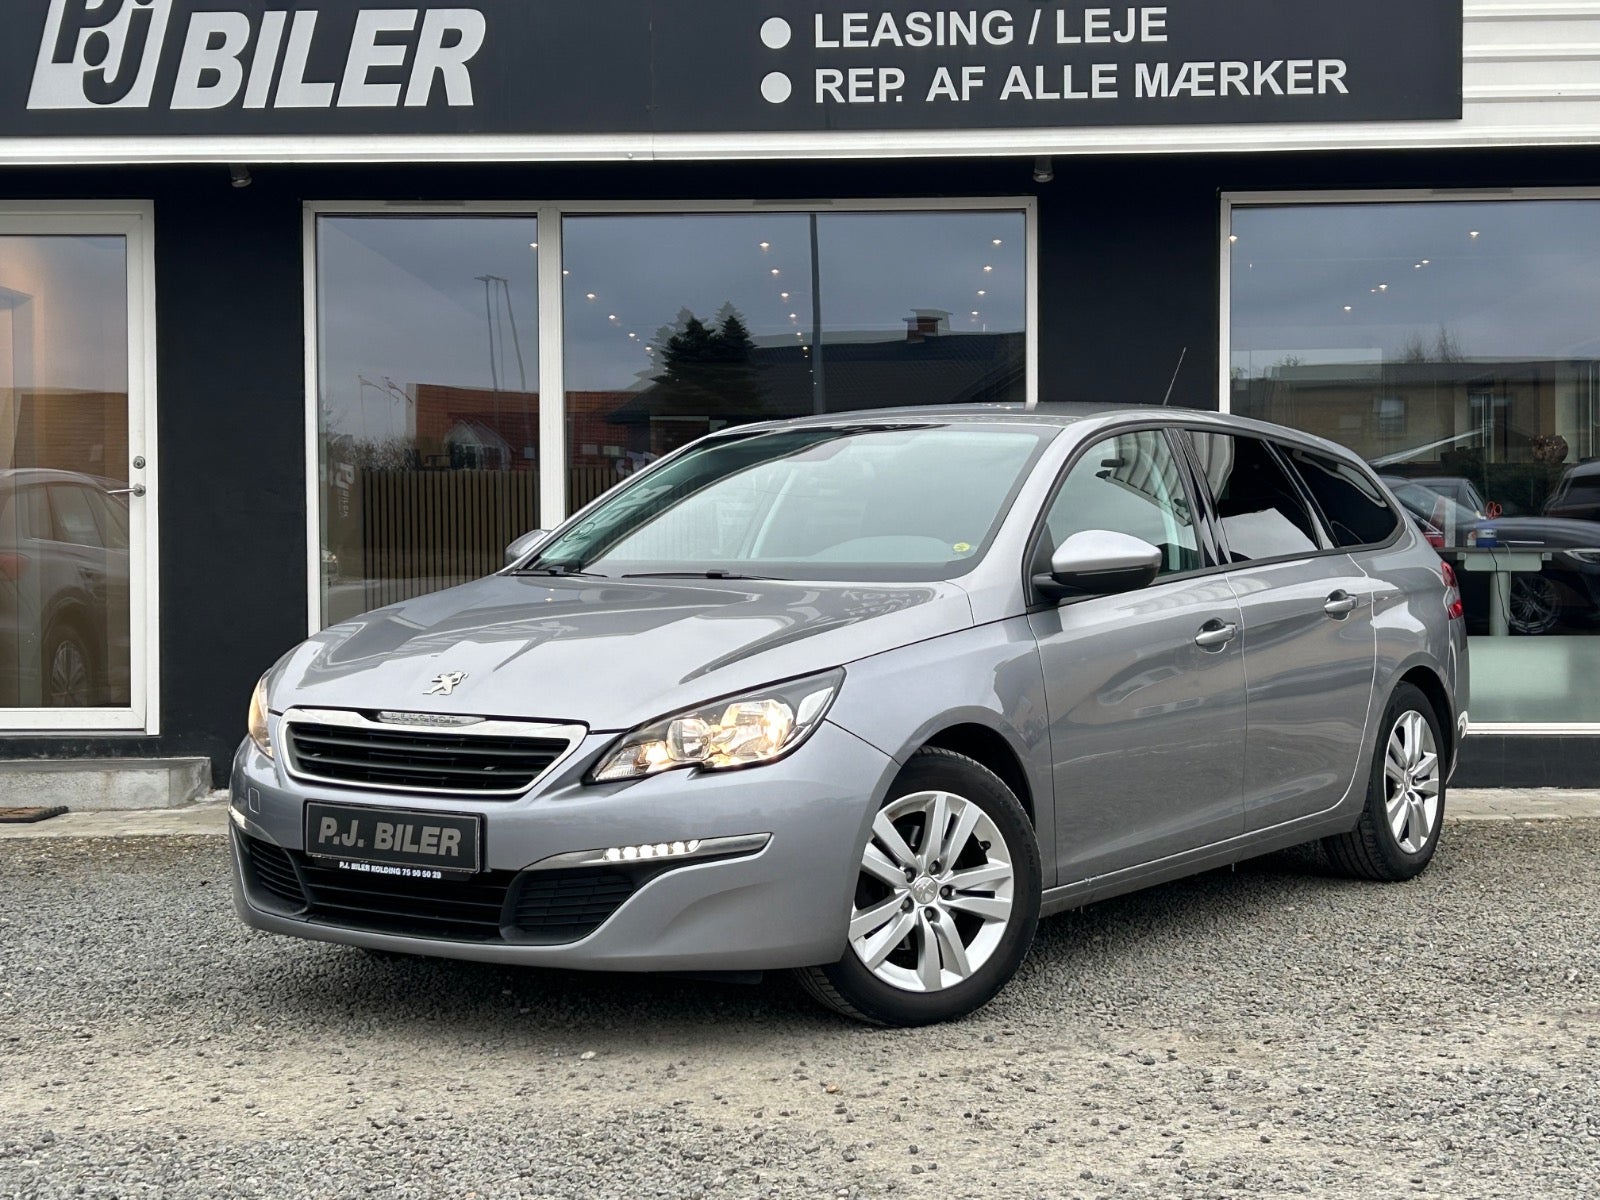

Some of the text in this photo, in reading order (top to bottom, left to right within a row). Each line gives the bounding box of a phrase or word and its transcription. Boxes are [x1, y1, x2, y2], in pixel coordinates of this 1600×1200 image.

[815, 7, 1168, 48] LEASING / LEJE
[170, 9, 487, 109] BILER
[815, 60, 1350, 103] REP. AF ALLE MÆRKER
[318, 816, 462, 857] P.J. BILER
[351, 862, 370, 872] BILER
[371, 865, 401, 875] KOLDING
